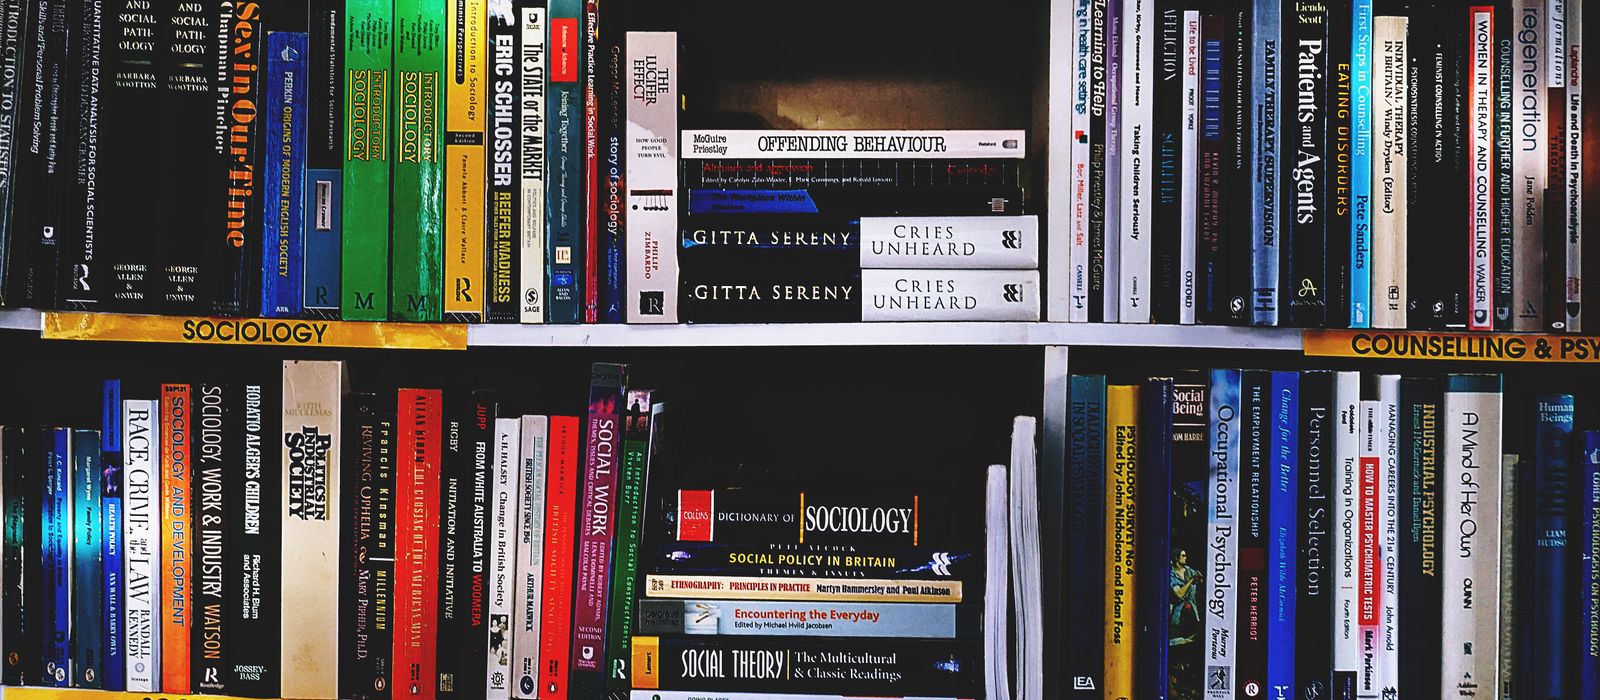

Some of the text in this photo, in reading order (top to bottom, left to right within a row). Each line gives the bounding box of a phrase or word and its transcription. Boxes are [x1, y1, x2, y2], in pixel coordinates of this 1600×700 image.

[588, 13, 596, 43] Effective
[1295, 2, 1326, 11] Liendo
[1299, 15, 1322, 24] Scott
[90, 68, 98, 95] DATA
[215, 1, 233, 154] Chapman Pincher
[588, 45, 596, 73] Practice
[634, 60, 644, 100] EFFECT
[646, 56, 656, 105] LUCIFER
[658, 68, 668, 93] THE
[1355, 5, 1370, 155] First Steps in Counselling
[1519, 8, 1540, 151] regeneration
[353, 70, 367, 161] SOCIOLOGY
[372, 71, 382, 160] INTRODUCTORY
[494, 35, 513, 186] ERIC SCHLOSSER
[523, 43, 543, 181] The STATE or the MARKET
[586, 75, 595, 106] Learning
[89, 96, 97, 144] ANALYSIS
[227, 1, 260, 248] Sex in Our Time
[404, 71, 418, 163] SOCIOLOGY
[423, 73, 433, 161] INTRODUCTORY
[694, 134, 727, 143] McGuire
[1293, 39, 1322, 224] Patients and Agents
[1337, 64, 1349, 216] EATING DISORDERS
[88, 145, 96, 163] FOR
[693, 144, 728, 155] Priestley
[758, 136, 947, 152] OFFENDING BEHAVIOUR
[1476, 21, 1488, 302] WOMEN IN THERAPY AND COUNSELLING WALKER
[87, 164, 95, 202] SOCIAL
[279, 72, 293, 276] PERKIN ORIGINS OF MODERN ENGLISH SOCIETY
[607, 137, 620, 234] story of sociology
[1131, 125, 1141, 240] Taking Children Seriously
[1525, 176, 1535, 195] Jane
[85, 205, 94, 260] SCIENTISTS
[498, 192, 512, 302] REEFER MADNESS
[694, 230, 850, 245] GITTA SERENY
[872, 241, 975, 255] UNHEARD
[894, 225, 953, 239] CRIES
[1355, 195, 1368, 269] Pete Sanders
[695, 285, 852, 300] GITTA SERENY
[873, 295, 977, 309] UNHEARD
[895, 279, 955, 293] CRIES
[183, 320, 328, 343] SOCIOLOGY
[1352, 334, 1527, 358] COUNSELLING
[1534, 338, 1552, 359] &
[126, 408, 149, 465] RACE,
[245, 385, 260, 534] HORATIO ALGER'S CHILDREN
[284, 432, 304, 520] SOCIETY
[303, 426, 318, 520] INDUSTRIAL
[315, 434, 331, 520] POLITICS IN
[592, 419, 613, 536] SOCIAL WORK
[1343, 457, 1354, 495] Training
[1422, 404, 1435, 576] INDUSTRIAL PSYCHOLOGY
[1460, 412, 1480, 558] A Mind of Her Own
[173, 396, 184, 626] SOCIOLOGY AND DEVELOPMENT
[200, 387, 222, 659] SOCIOLOGY, WORK & INDUSTRY WATSON
[471, 403, 487, 626] JUPP FROM WHITE AUSTRALIA TO WOOMERA
[718, 505, 912, 533] DICTIONARY OF SOCIOLOGY
[1209, 405, 1235, 619] Occupational Psychology
[1308, 407, 1326, 596] Personnel Selection
[128, 539, 139, 554] the
[140, 538, 152, 555] and
[729, 553, 896, 568] SOCIAL POLICY IN BRITAIN
[1342, 509, 1354, 577] Organizations
[1363, 464, 1374, 620] HOW TO MASTER PSYCHOMETRIC TESTS
[128, 558, 149, 605] LAW
[128, 609, 139, 658] KENNEDY
[140, 609, 150, 659] RANDALL
[735, 608, 879, 623] Encountering the Everyday
[681, 649, 784, 679] SOCIAL THEORY
